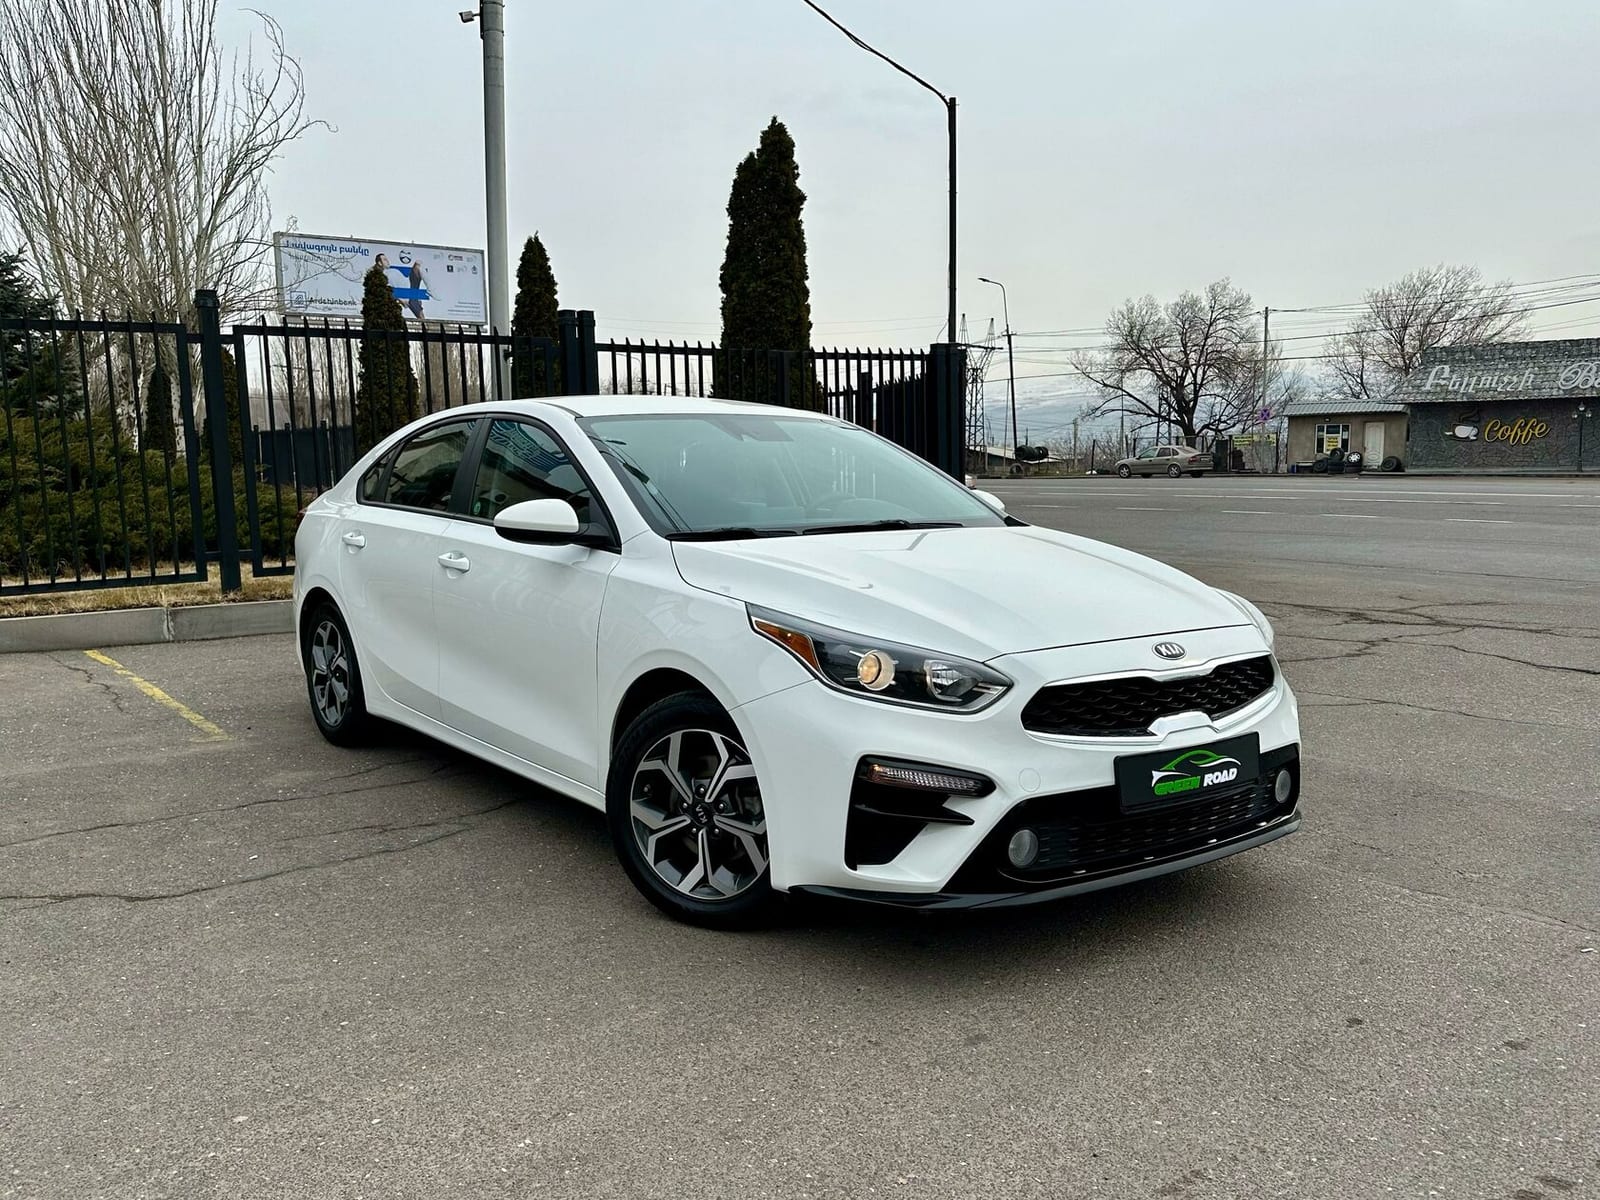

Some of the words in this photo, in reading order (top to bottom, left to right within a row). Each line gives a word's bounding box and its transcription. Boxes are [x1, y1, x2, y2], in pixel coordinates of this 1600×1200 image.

[339, 244, 370, 257] բանկը
[1484, 417, 1552, 446] Coffe
[1155, 643, 1185, 657] KIA
[1155, 775, 1201, 796] GREEN
[1203, 767, 1238, 787] ROAD
[695, 804, 708, 823] KIA
